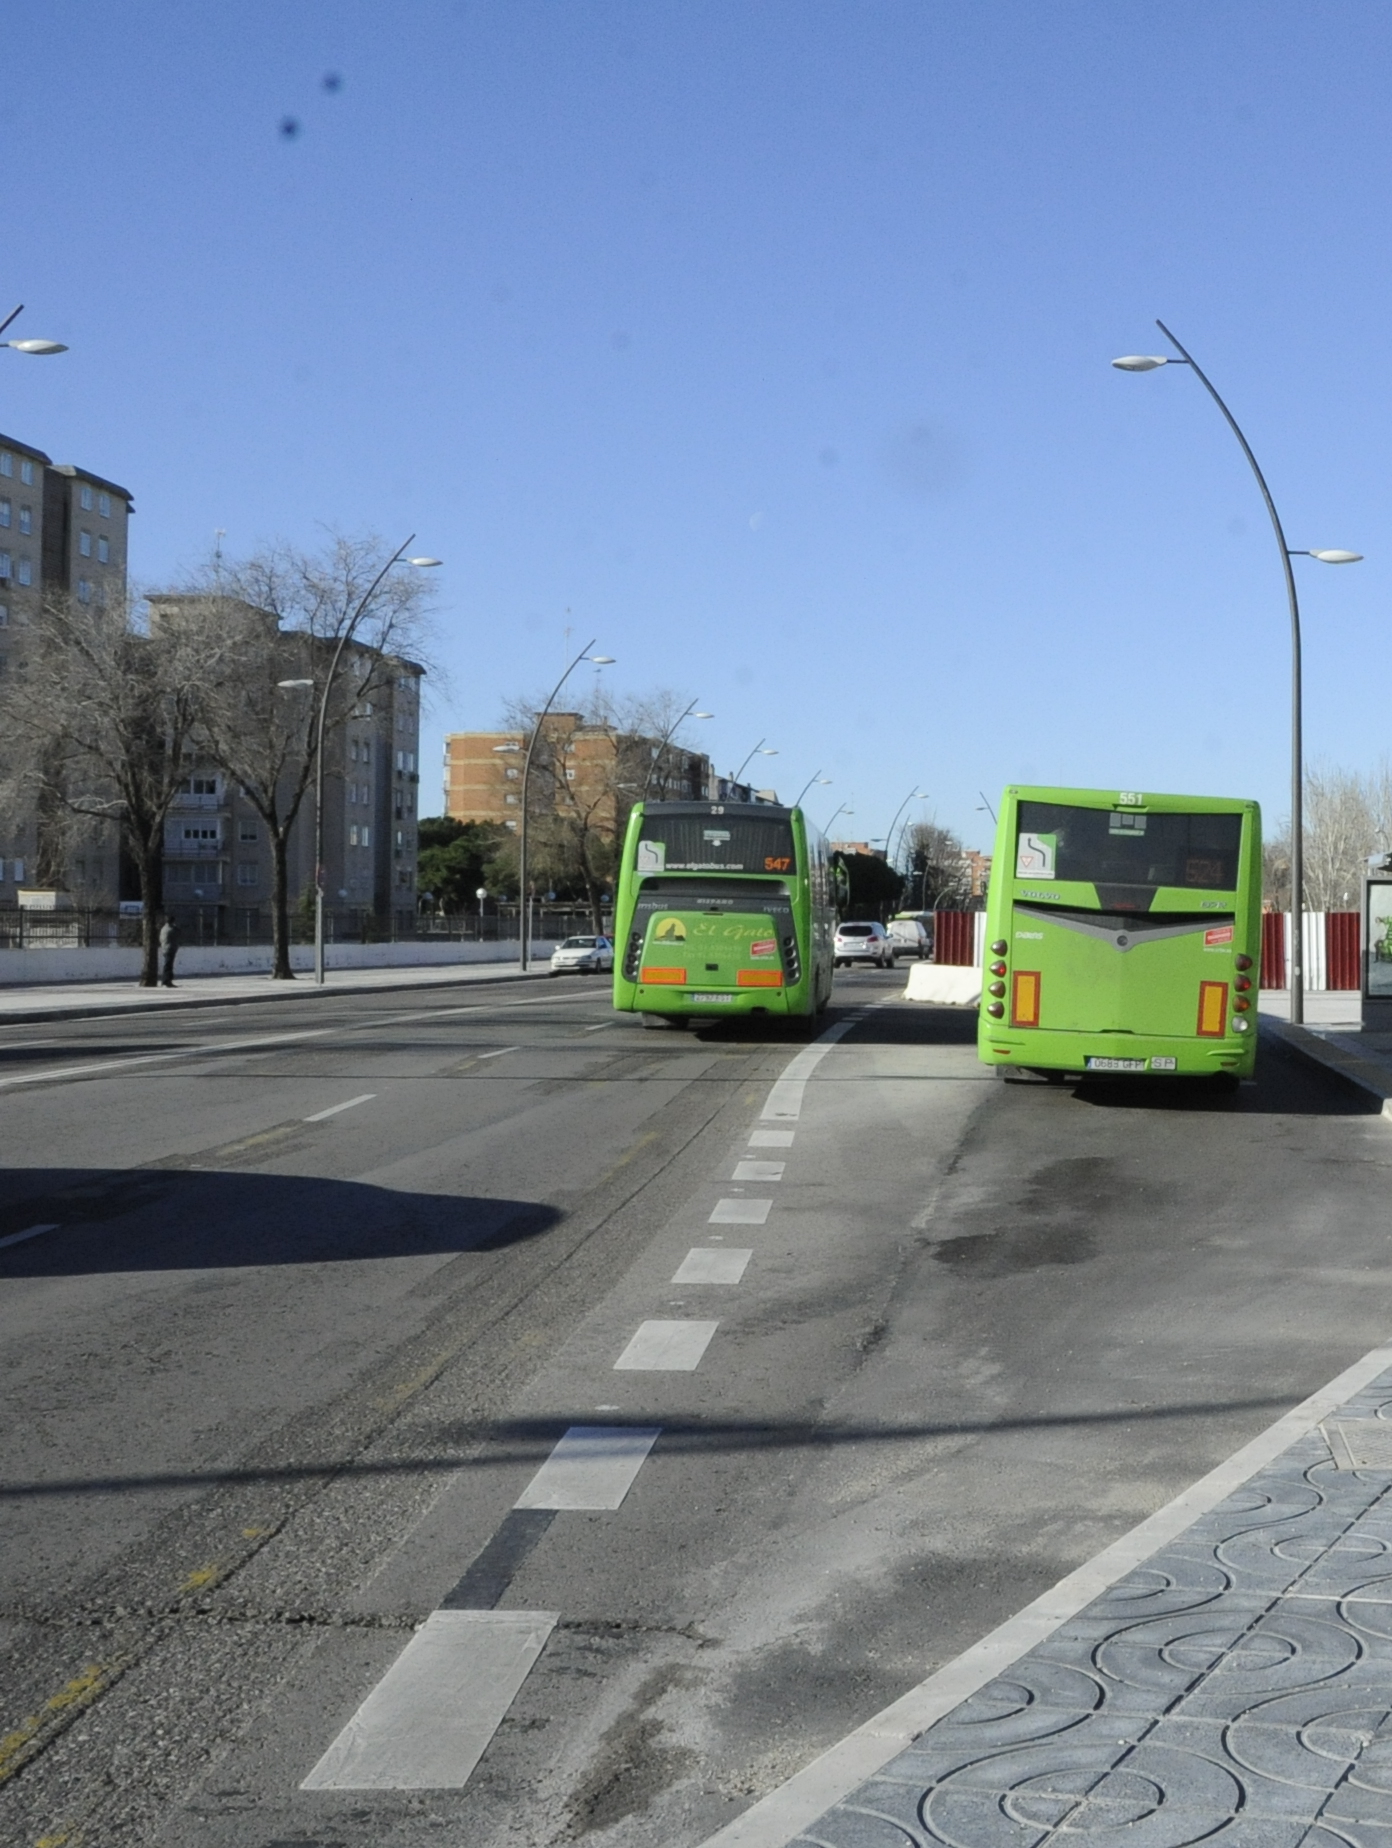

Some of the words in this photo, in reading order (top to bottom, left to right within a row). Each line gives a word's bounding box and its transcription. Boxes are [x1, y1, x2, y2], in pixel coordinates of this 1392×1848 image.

[1119, 792, 1143, 805] 551
[711, 805, 724, 815] 29
[763, 857, 790, 871] 547
[1186, 859, 1226, 884] 524
[1020, 889, 1061, 901] VOLVO
[693, 923, 716, 936] El
[723, 925, 773, 940] Gato
